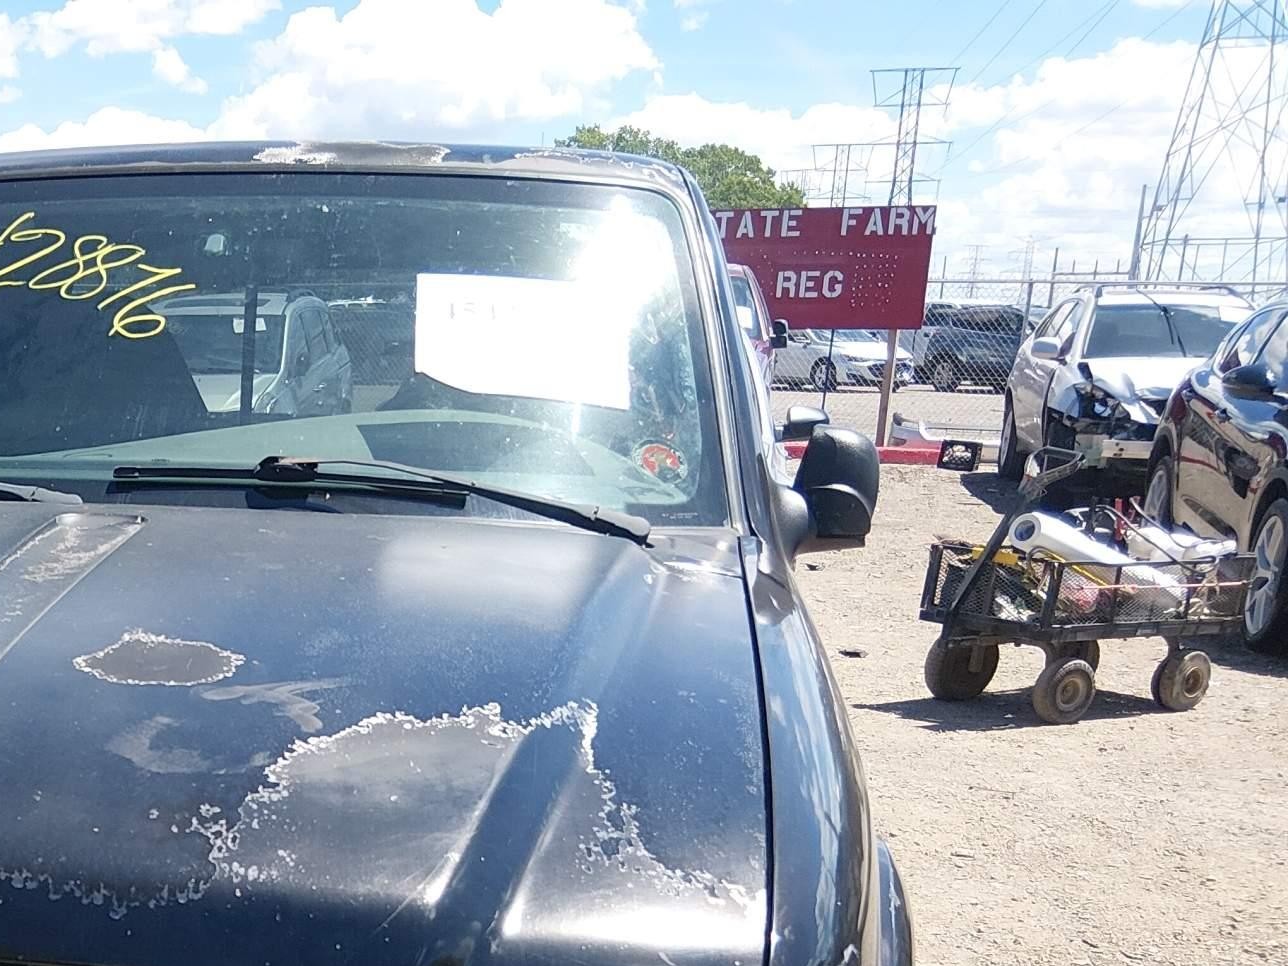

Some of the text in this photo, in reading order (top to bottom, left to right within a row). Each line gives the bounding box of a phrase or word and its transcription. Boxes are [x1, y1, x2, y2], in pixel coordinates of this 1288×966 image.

[715, 207, 935, 239] TATE FARM
[775, 270, 844, 299] REG
